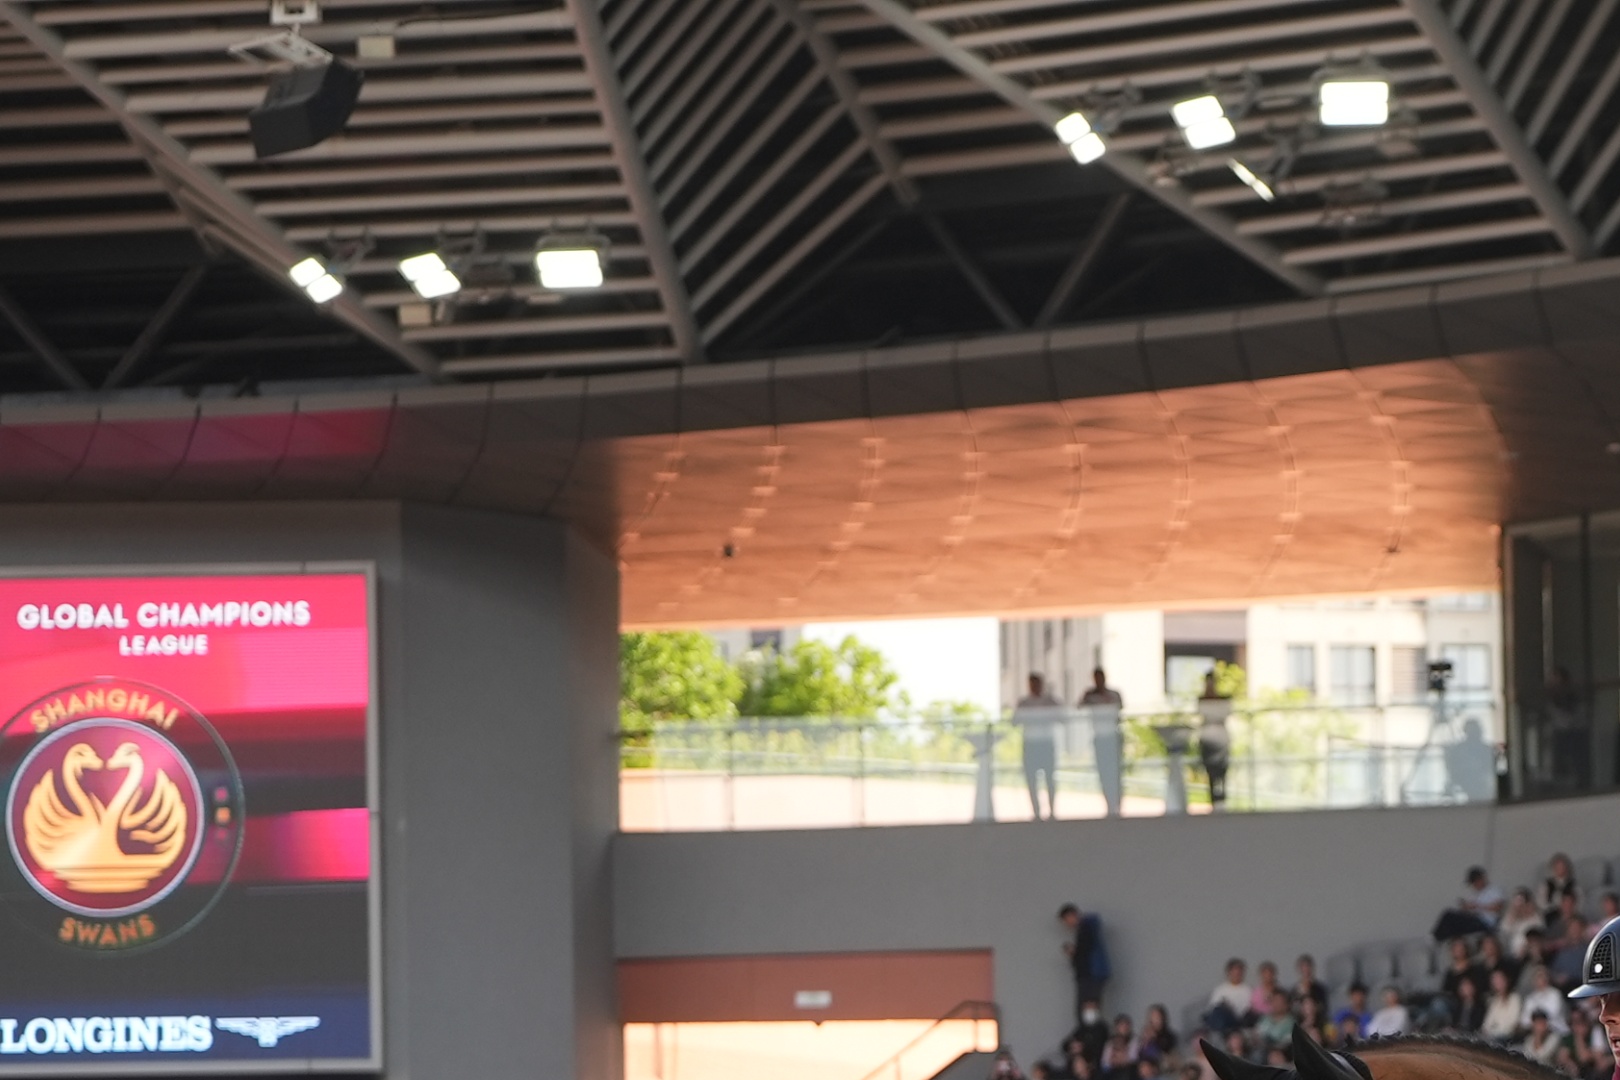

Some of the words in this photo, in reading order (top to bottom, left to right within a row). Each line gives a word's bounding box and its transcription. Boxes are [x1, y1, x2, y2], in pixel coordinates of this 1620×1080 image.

[17, 603, 129, 630] GLOBAL
[137, 600, 311, 628] CHAMPIONS
[119, 634, 208, 656] LEAGUE
[30, 688, 179, 732] SHANGHAI
[59, 914, 156, 945] SWANS
[0, 1015, 213, 1054] LONGINES
